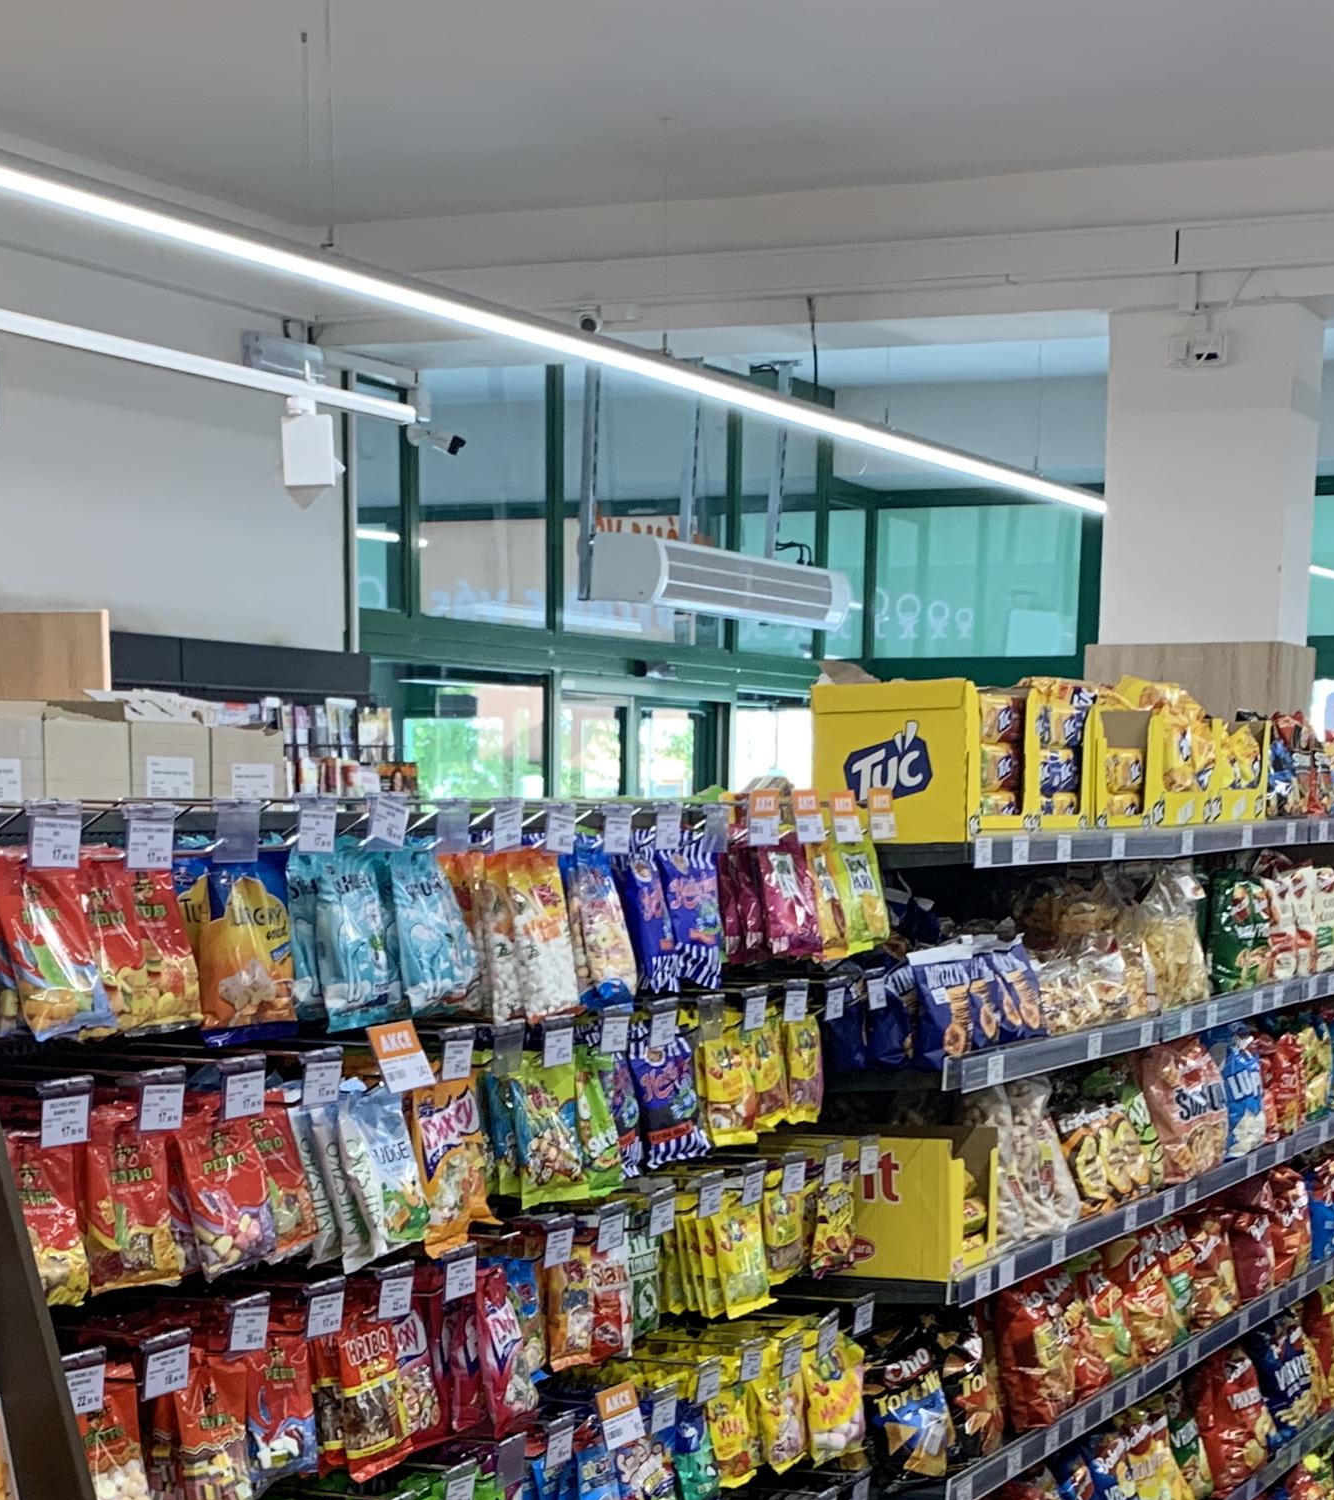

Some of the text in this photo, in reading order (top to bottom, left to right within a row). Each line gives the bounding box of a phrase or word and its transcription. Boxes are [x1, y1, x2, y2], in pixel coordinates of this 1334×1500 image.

[851, 750, 924, 806] TUC
[380, 1030, 414, 1053] AKCE
[202, 1152, 247, 1176] PEDRO
[369, 1141, 410, 1167] UDGE
[345, 1325, 392, 1366] HARIBO
